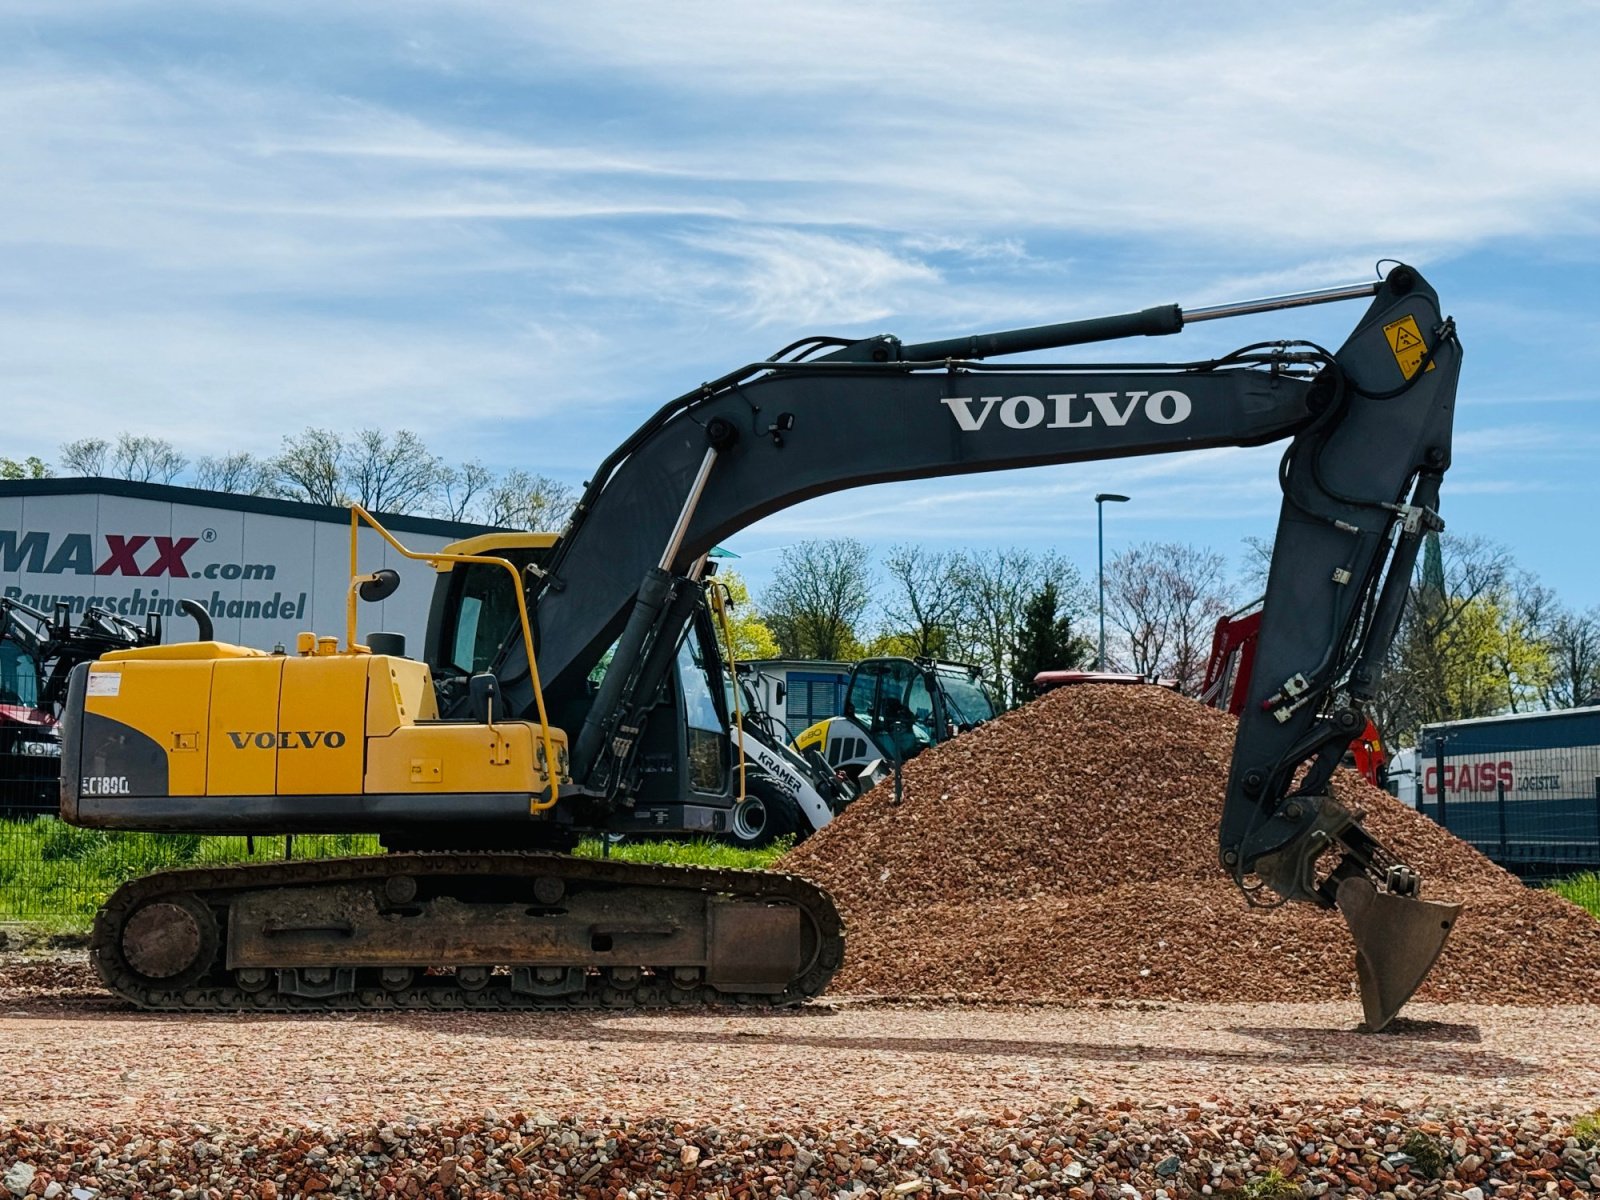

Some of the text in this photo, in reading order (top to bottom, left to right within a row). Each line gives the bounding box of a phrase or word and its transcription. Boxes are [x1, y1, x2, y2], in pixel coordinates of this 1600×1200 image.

[940, 390, 1192, 431] VOLVO
[227, 731, 346, 749] VOLVO
[757, 751, 803, 793] KRAMER
[1517, 775, 1561, 791] LOGISTIK
